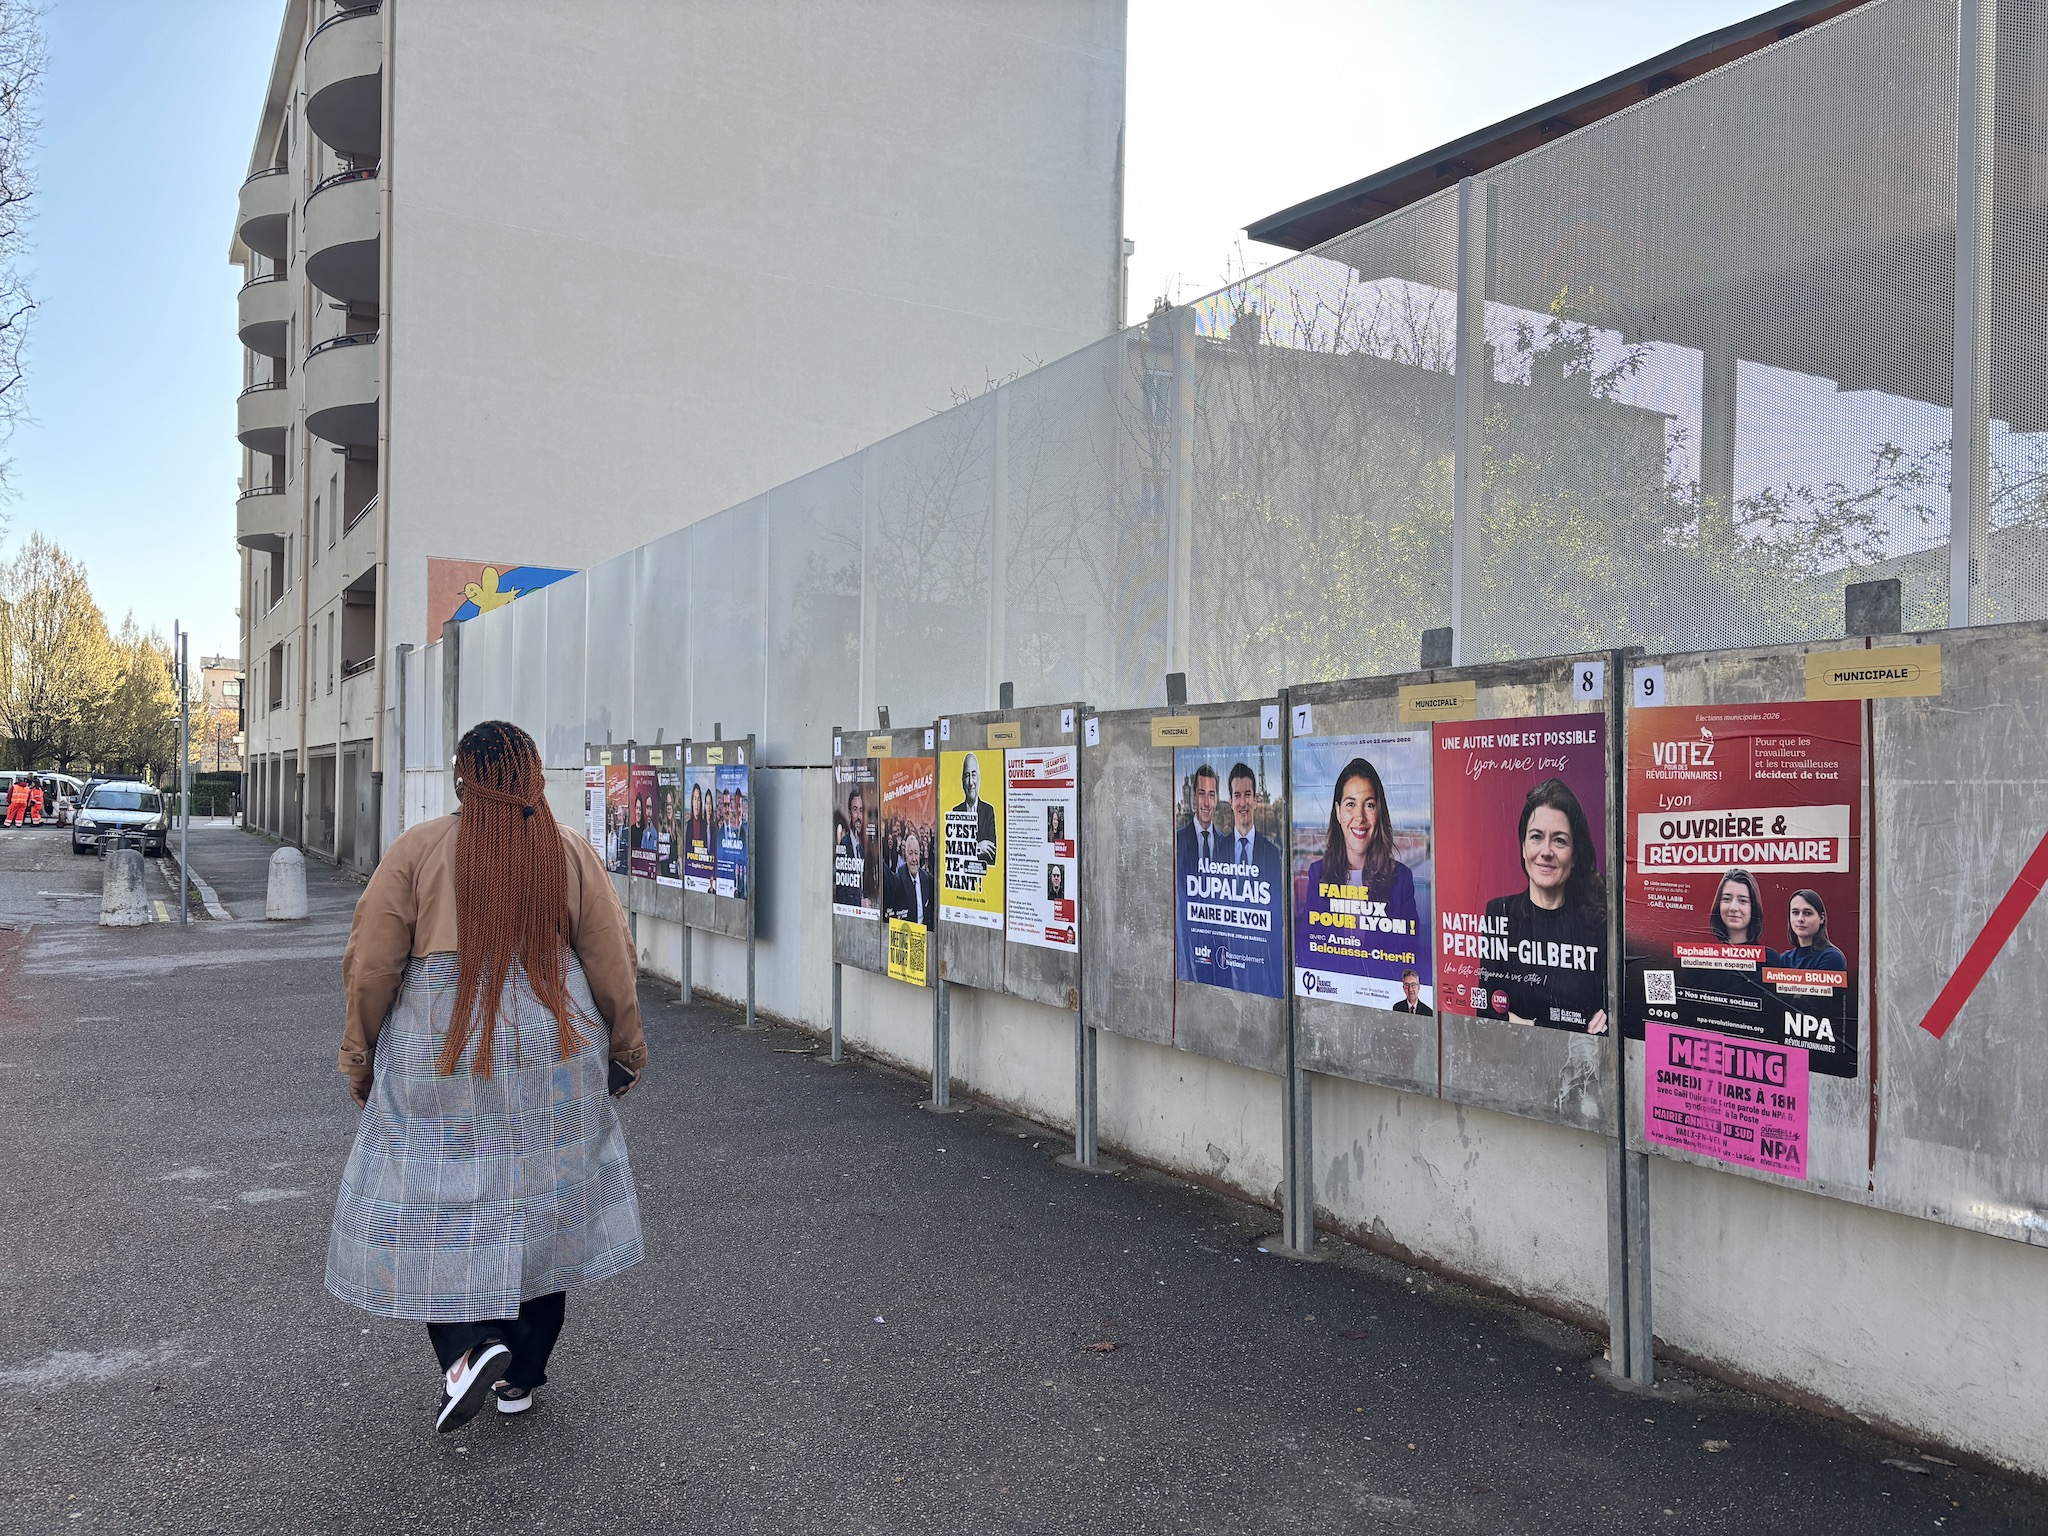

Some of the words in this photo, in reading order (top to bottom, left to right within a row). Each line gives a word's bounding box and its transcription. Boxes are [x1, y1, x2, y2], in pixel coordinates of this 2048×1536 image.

[1582, 671, 1594, 691] 8
[1834, 668, 1908, 682] MUNICIPALE
[1644, 678, 1654, 696] 9
[1416, 699, 1457, 708] MUNICIPALE
[1065, 715, 1070, 728] 4
[1268, 717, 1273, 730] 6
[1299, 712, 1306, 729] 7
[1695, 714, 1723, 722] Élections
[1090, 725, 1095, 736] 5
[1442, 737, 1461, 750] UNE
[1463, 735, 1494, 749] AUTRE
[1497, 734, 1520, 747] VOIE
[1522, 733, 1541, 746] EST
[1544, 730, 1596, 745] POSSIBLE
[1755, 738, 1776, 746] Pour
[1779, 738, 1795, 748] que
[1798, 736, 1810, 746] les
[1652, 742, 1714, 766] VOTEZ
[1755, 749, 1806, 757] travailleurs
[1008, 760, 1024, 768] LUTTE
[1465, 752, 1499, 781] Lyon
[1501, 756, 1535, 771] avec
[1538, 755, 1569, 772] vous
[1766, 760, 1778, 768] les
[1781, 760, 1838, 768] travailleuses
[914, 774, 932, 790] AULAS
[1646, 768, 1718, 780] RÉVOLUTIONNAIRES
[1755, 770, 1797, 779] décident
[1800, 770, 1813, 779] de
[1658, 793, 1692, 810] Lyon
[946, 824, 976, 839] C'EST
[1659, 813, 1764, 840] OUVRIÈRE
[1771, 814, 1787, 836] &
[946, 840, 980, 856] MAIN-
[1650, 841, 1831, 865] RÉVOLUTIONNAIRE
[836, 854, 864, 872] GRÉGORY
[946, 857, 963, 871] TE-
[1198, 858, 1259, 878] Alexandre
[836, 872, 860, 888] DOUCET
[945, 874, 977, 891] NANT
[1186, 875, 1271, 905] DUPALAIS
[1319, 883, 1368, 900] FAIRE
[1330, 898, 1387, 917] MIEUX
[1190, 905, 1221, 921] MAIRE
[1224, 910, 1237, 923] DE
[1240, 912, 1267, 927] LYON
[1309, 911, 1357, 929] POUR
[1359, 916, 1406, 935] LYON
[1410, 920, 1415, 936] !
[1442, 912, 1509, 936] NATHALIE
[1328, 934, 1361, 947] Anaïs
[1195, 946, 1211, 958] udr
[1226, 952, 1265, 964] Rassemblement
[1309, 942, 1415, 964] Belouassa-Cherifi
[1443, 933, 1599, 971] PERRIN-GILBERT
[1677, 945, 1719, 957] Raphaëlle
[1721, 947, 1761, 958] MIZONY
[1226, 960, 1246, 969] National
[1444, 962, 1457, 973] Une
[1458, 964, 1473, 978] liste
[1683, 959, 1712, 967] étudiante
[1724, 961, 1755, 970] espagnol
[1766, 972, 1802, 983] Anthony
[1805, 972, 1842, 984] BRUNO
[1472, 989, 1485, 999] NPG
[1778, 985, 1808, 994] aiguilleur
[1820, 986, 1831, 994] rail
[1471, 998, 1487, 1008] 2026
[1493, 995, 1507, 1004] LYON
[1684, 990, 1698, 999] Nos
[1699, 992, 1728, 1003] réseaux
[1730, 998, 1759, 1008] sociaux
[1561, 1009, 1581, 1018] ÉLECTION
[1697, 1017, 1764, 1034] npa-revolutionnaires.org
[1784, 1011, 1836, 1042] NPA
[1784, 1037, 1836, 1053] RÉVOLUTIONNAIRES
[1672, 1036, 1784, 1084] MEETING
[1657, 1070, 1701, 1090] SAMEDI
[1756, 1088, 1765, 1104] À
[1771, 1093, 1796, 1110] 18H
[1657, 1087, 1672, 1095] avec
[1674, 1089, 1688, 1098] Gaël
[1738, 1104, 1760, 1115] parole
[1762, 1108, 1770, 1116] du
[1654, 1107, 1683, 1123] MAIRIE
[1734, 1126, 1753, 1139] SUD
[1740, 1113, 1759, 1124] Poste
[1676, 1127, 1728, 1147] VAULX-EN-VELN
[1760, 1138, 1800, 1164] NPA
